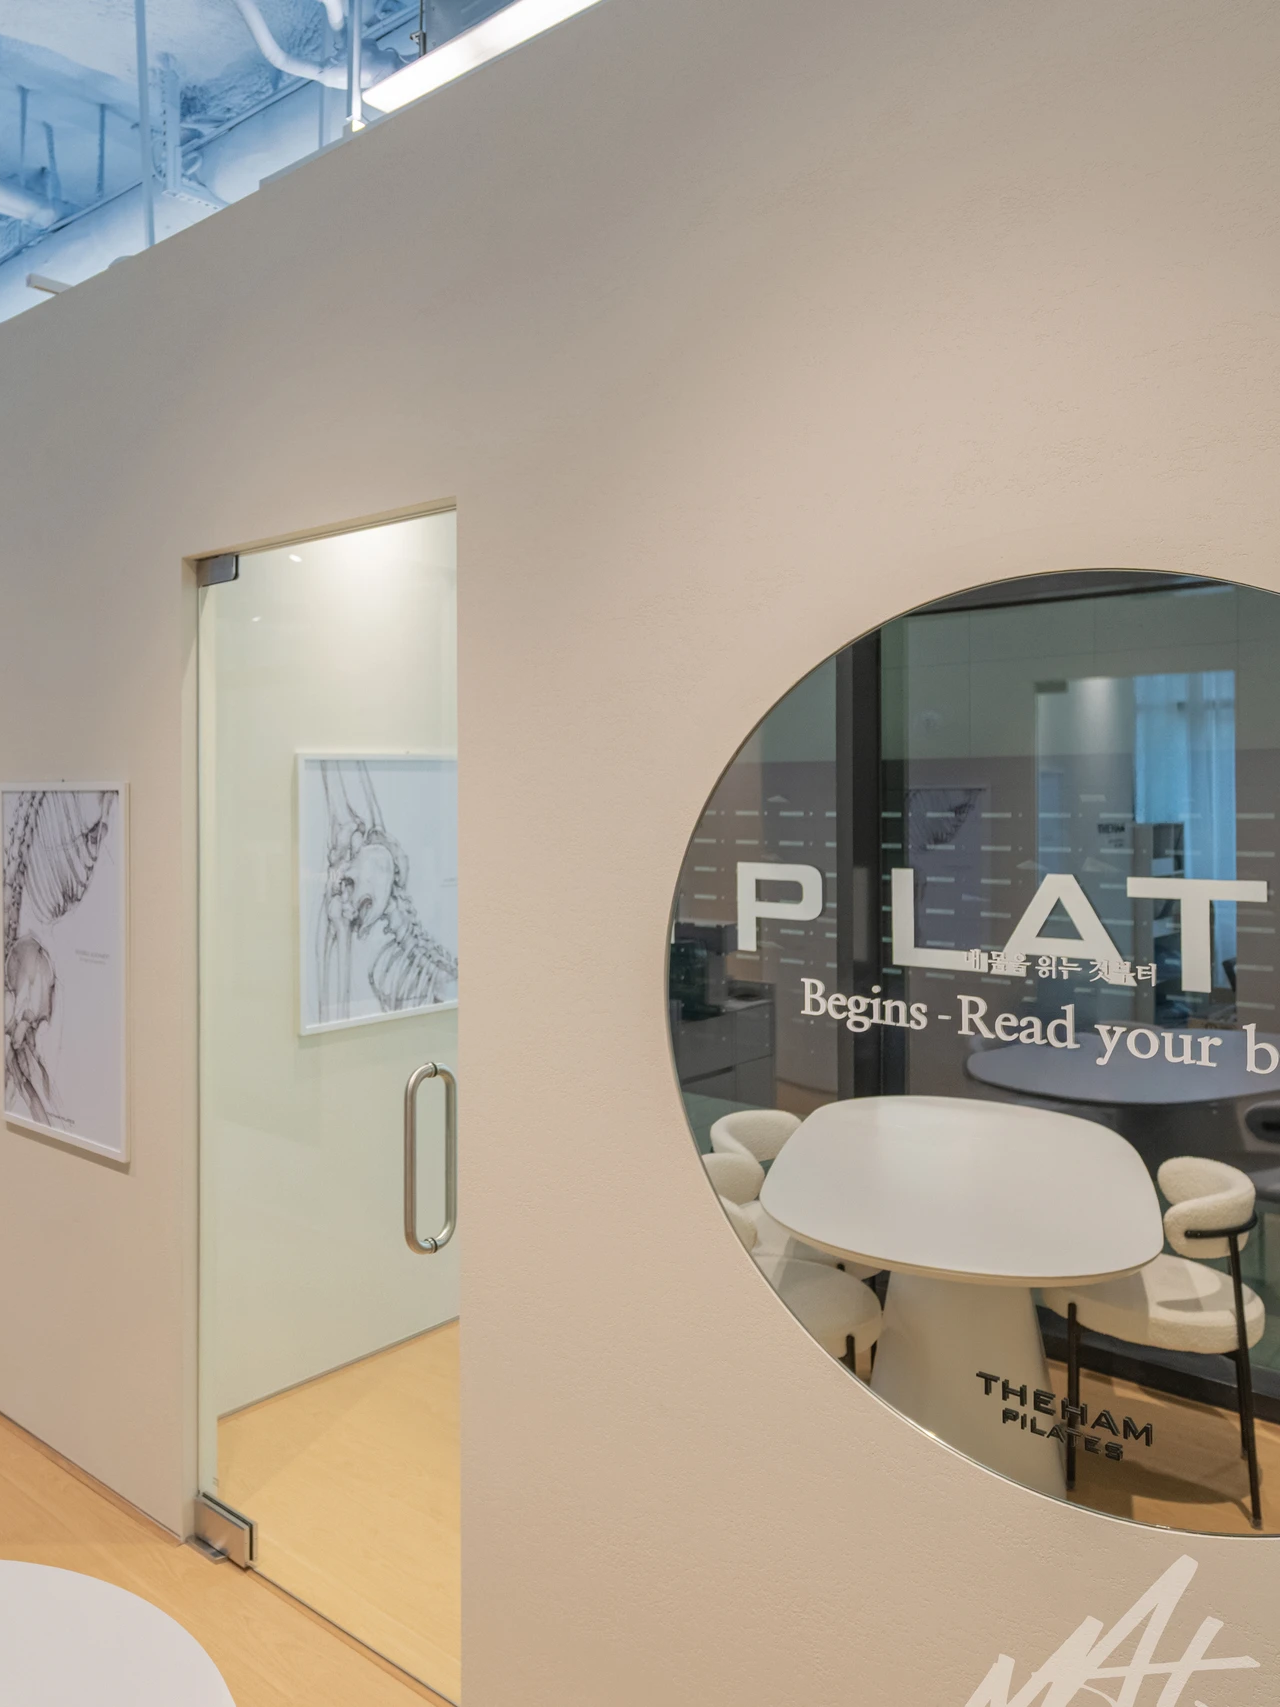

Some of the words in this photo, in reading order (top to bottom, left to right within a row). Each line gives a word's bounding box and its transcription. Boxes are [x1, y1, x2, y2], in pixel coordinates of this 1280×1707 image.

[988, 951, 1031, 974] 몸을
[1035, 956, 1082, 980] 읽는
[1089, 960, 1157, 987] 것부터
[801, 978, 928, 1033] Begins
[1094, 1024, 1223, 1066] your
[1242, 1023, 1280, 1075] b
[976, 1371, 1153, 1447] THEHAM
[1002, 1407, 1124, 1461] PILATES
